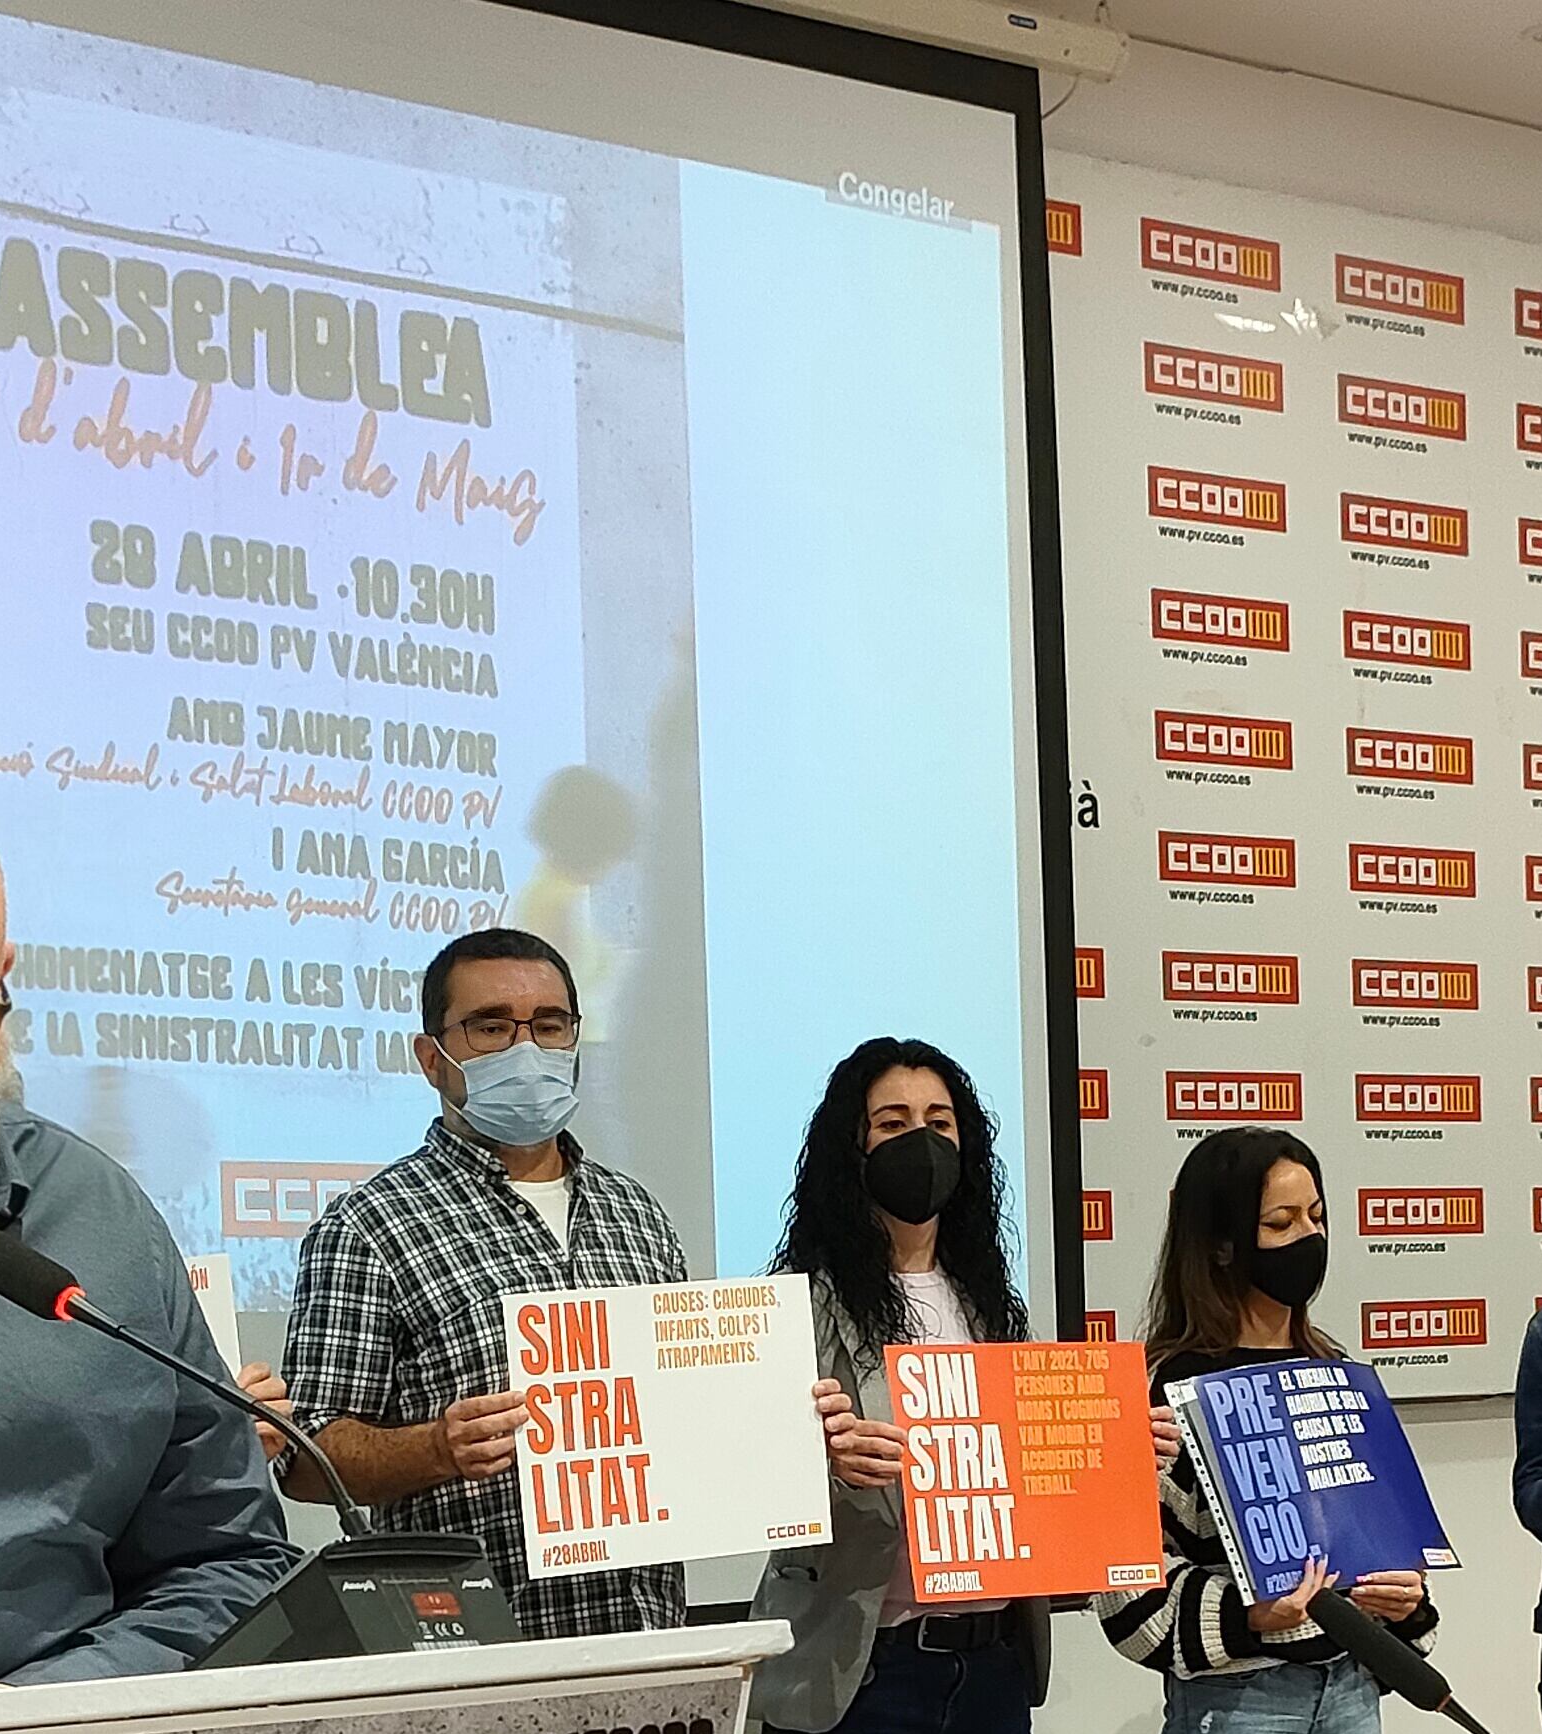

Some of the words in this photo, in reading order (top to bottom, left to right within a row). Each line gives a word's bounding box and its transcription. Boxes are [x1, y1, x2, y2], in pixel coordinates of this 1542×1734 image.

[839, 171, 954, 223] Congelar
[1150, 230, 1237, 274] CCOO
[1343, 266, 1425, 307] CCOO
[1153, 354, 1241, 396] CCOO
[342, 409, 398, 497] de
[1156, 477, 1244, 517] CCOO
[175, 531, 317, 610] ABRIL
[1160, 600, 1247, 637] CCOO
[85, 602, 154, 654] SEU
[166, 612, 258, 665] CCOO
[271, 625, 316, 672] PV
[328, 631, 499, 698] VALÈNCIA
[166, 696, 244, 747] AMB
[256, 706, 373, 761] JAUME
[383, 722, 497, 777] MAYOR
[1164, 721, 1250, 757] CCOO
[382, 780, 453, 824] CCOO
[461, 784, 502, 829] PV
[271, 826, 284, 872] I
[296, 830, 371, 879] ANA
[382, 837, 506, 895] GARCÍA
[1167, 842, 1254, 875] CCOO
[389, 891, 460, 934] CCOO
[11, 943, 232, 1001] HOMENATGE
[245, 958, 271, 1002] A
[281, 960, 344, 1008] LES
[46, 1010, 84, 1057] LA
[95, 1012, 364, 1072] SINISTRALITAT
[653, 1290, 708, 1314] CAUSES:
[713, 1285, 780, 1310] CAIGUDES,
[517, 1299, 610, 1376] SINI
[654, 1317, 714, 1342] INFARTS,
[718, 1313, 760, 1337] COLPS
[763, 1312, 769, 1334] I
[657, 1341, 761, 1370] ATRAPAMENTS.
[1085, 1349, 1109, 1370] 705
[896, 1352, 980, 1420] SINI
[1204, 1373, 1284, 1439] PRE
[525, 1376, 643, 1455] STRA
[908, 1423, 1009, 1491] STRA
[1223, 1437, 1301, 1501] VEN
[531, 1453, 669, 1534] LITAT.
[542, 1540, 610, 1568] #28ABRIL
[766, 1523, 807, 1540] CCOO
[914, 1494, 1031, 1564] LITAT.
